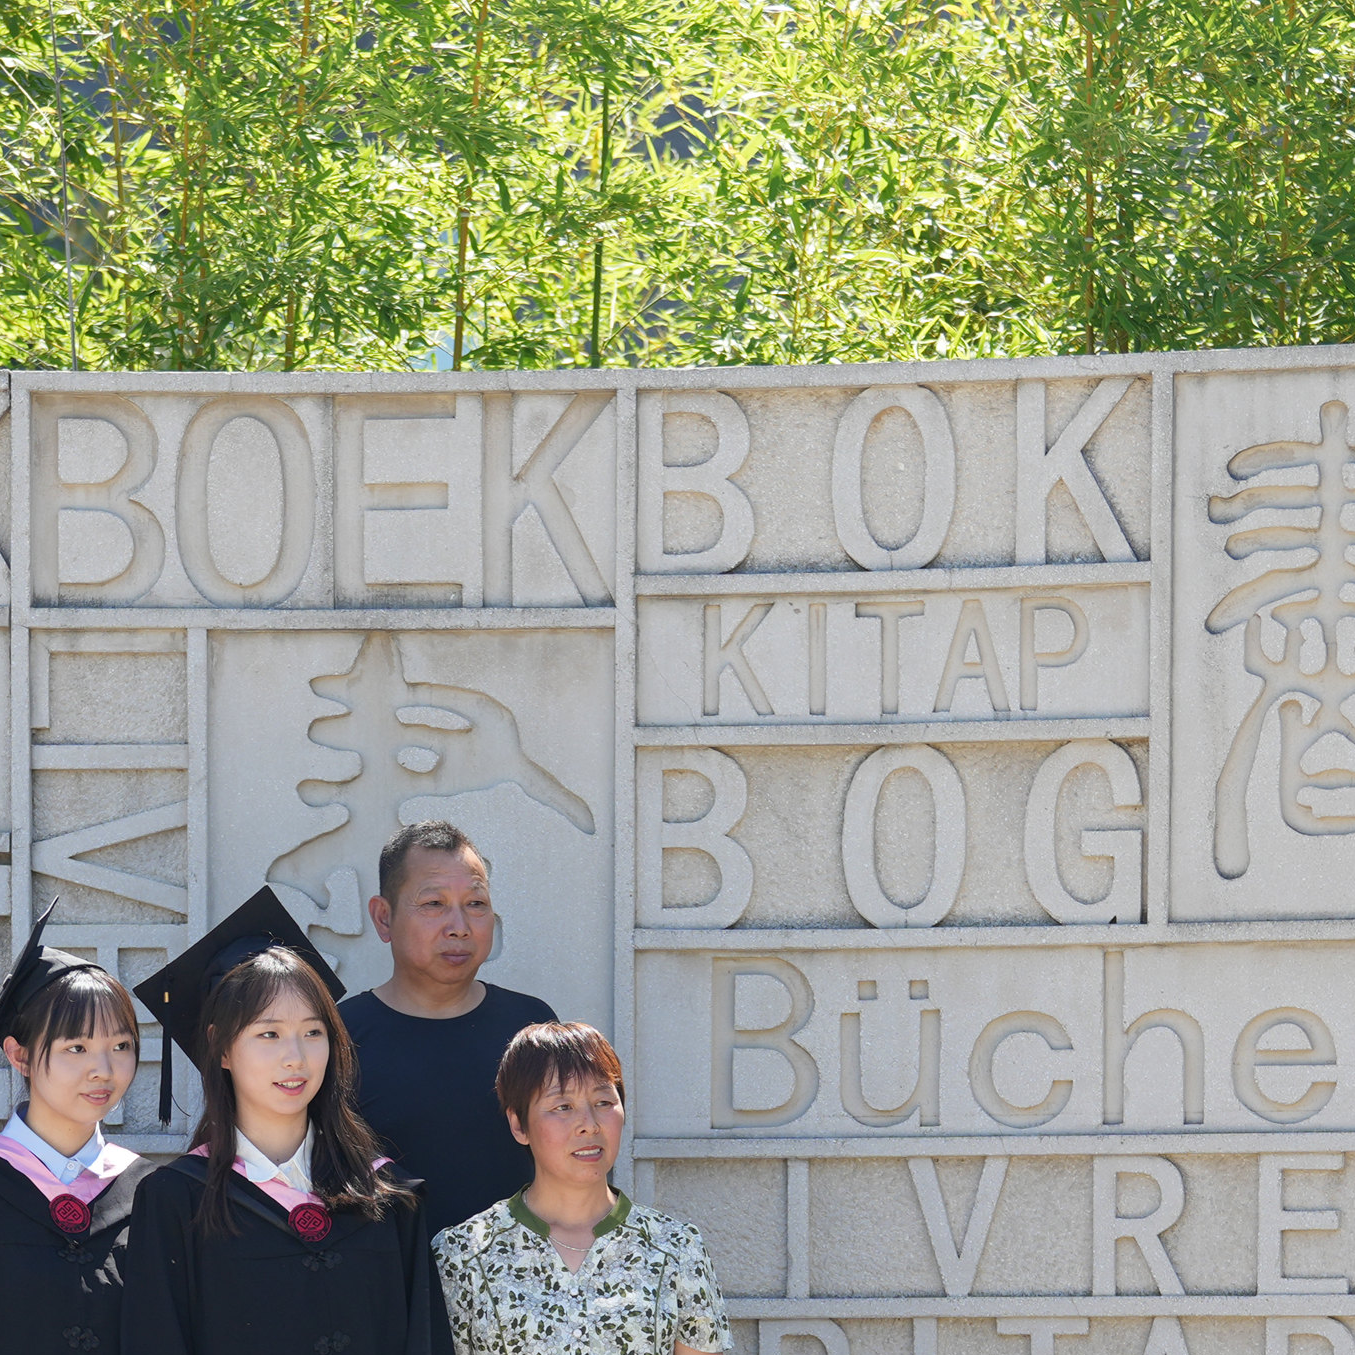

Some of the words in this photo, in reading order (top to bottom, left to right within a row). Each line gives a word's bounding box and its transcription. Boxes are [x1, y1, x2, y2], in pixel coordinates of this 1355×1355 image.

[32, 392, 615, 608] BOEK
[637, 375, 1142, 574] BOK
[701, 596, 1090, 717] KITAP
[636, 740, 1144, 930] BOG
